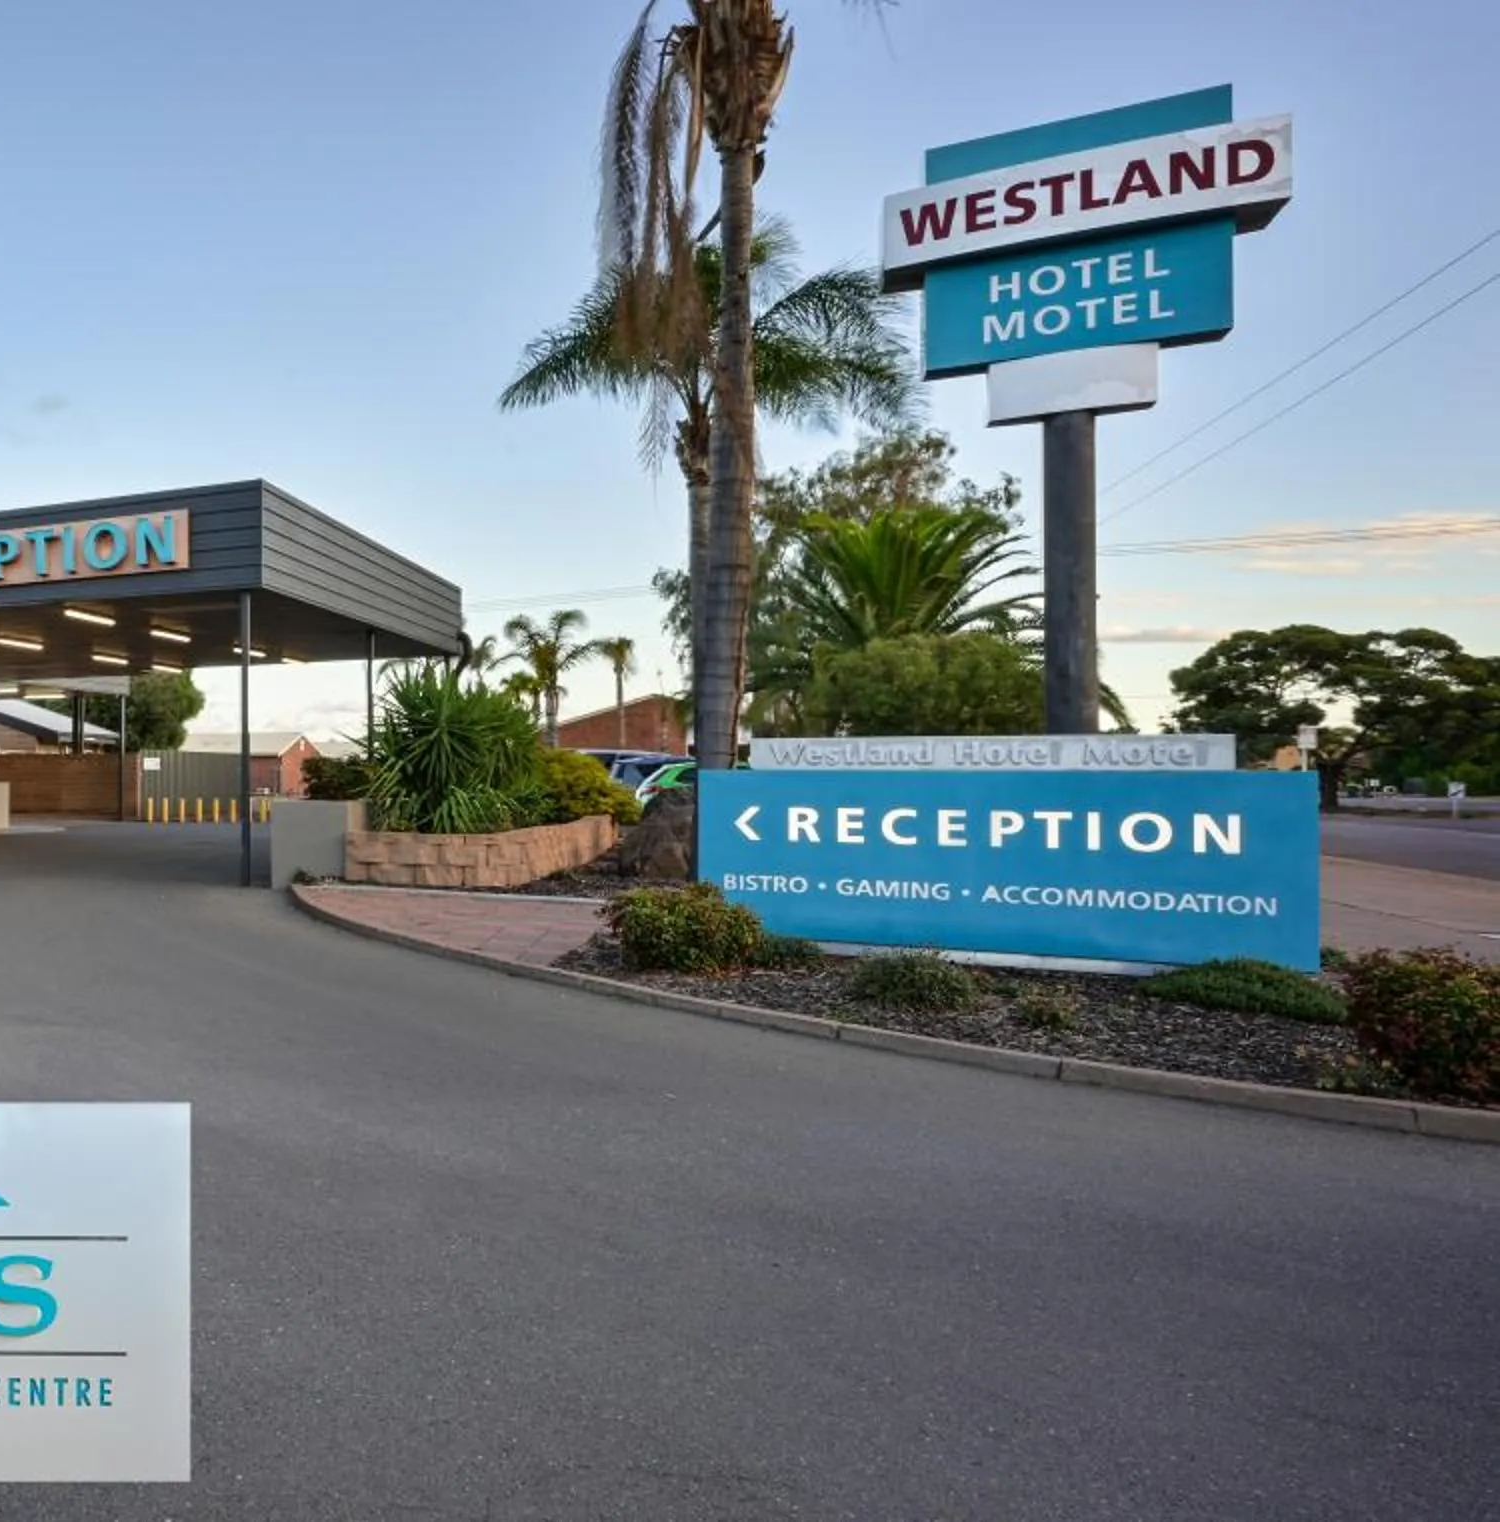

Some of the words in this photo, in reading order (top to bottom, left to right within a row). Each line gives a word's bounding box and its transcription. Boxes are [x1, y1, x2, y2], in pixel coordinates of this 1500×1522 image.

[900, 138, 1276, 247] WESTLAND
[989, 248, 1171, 303] HOTEL
[982, 289, 1176, 344] MOTEL
[787, 806, 1243, 855] RECEPTION
[723, 873, 808, 894] BISTRO
[836, 878, 951, 901] GAMING
[981, 885, 1278, 917] ACCOMMODATION
